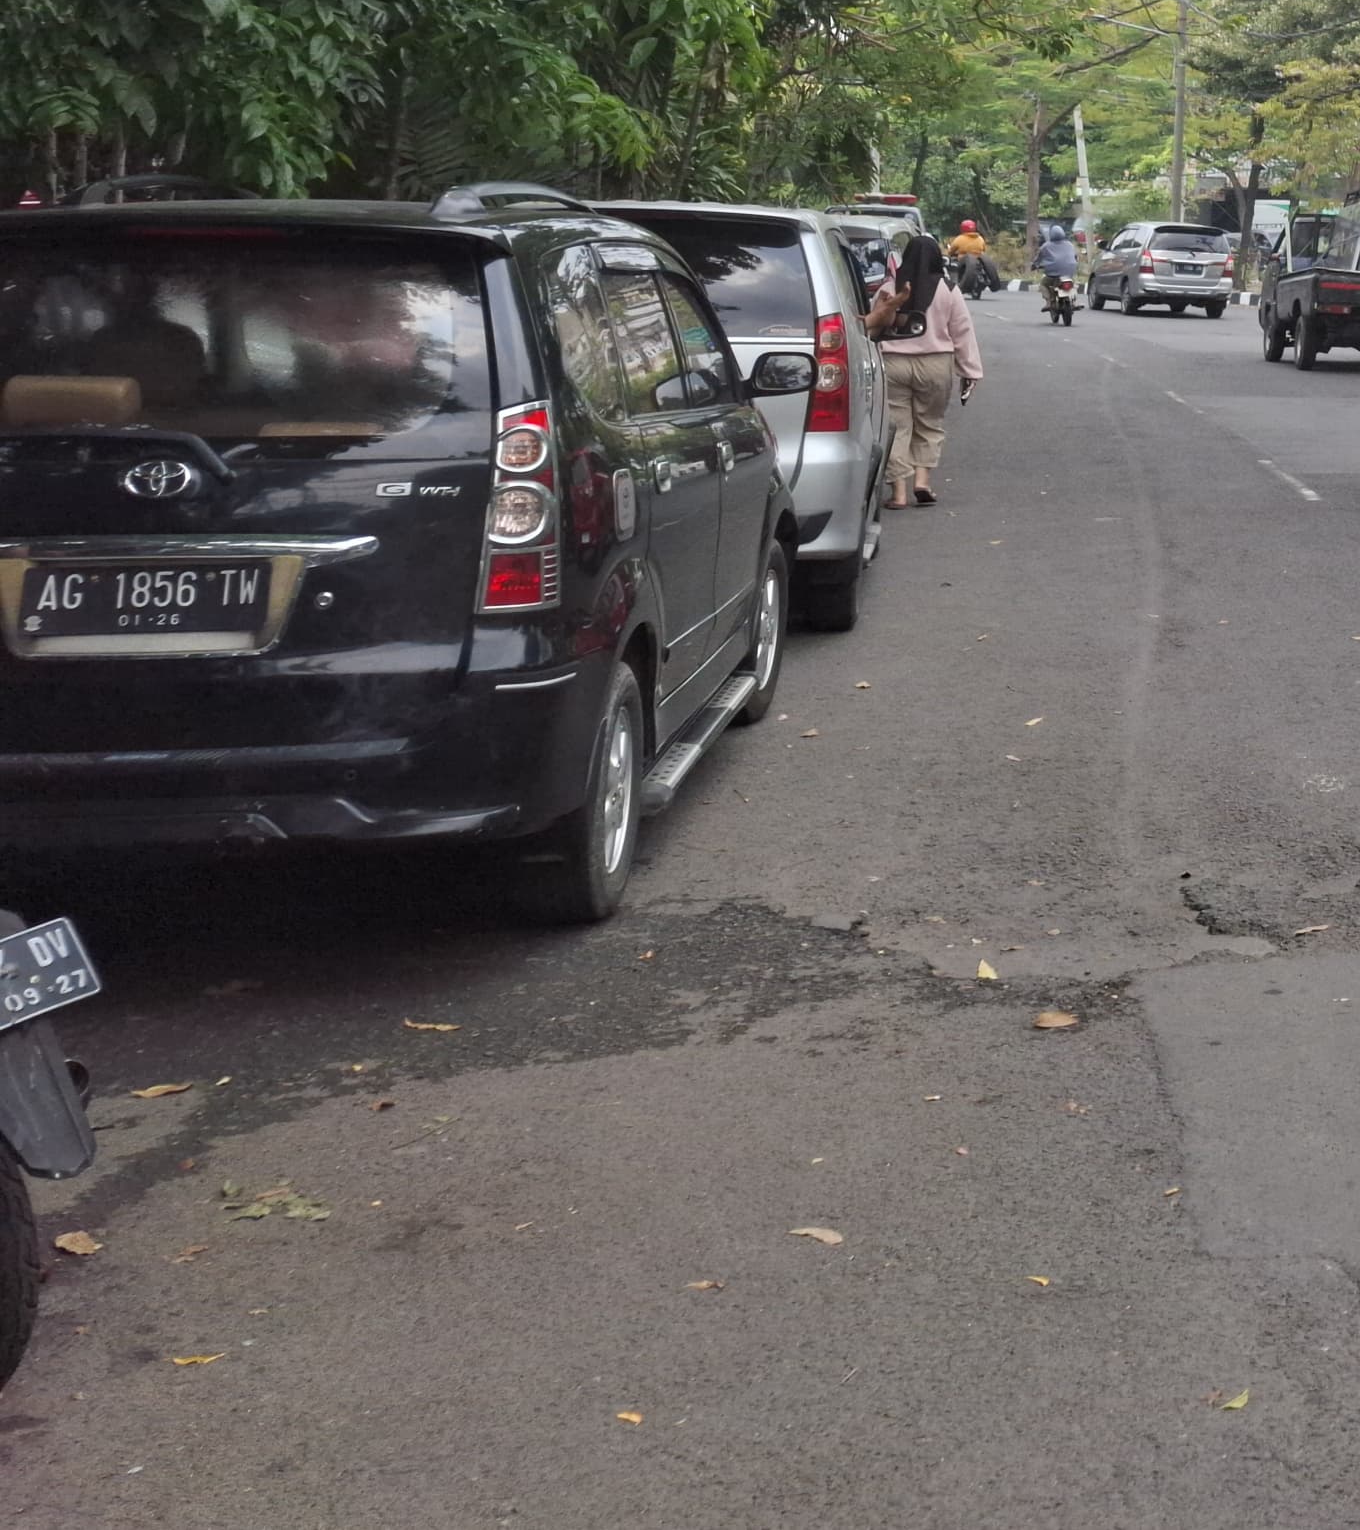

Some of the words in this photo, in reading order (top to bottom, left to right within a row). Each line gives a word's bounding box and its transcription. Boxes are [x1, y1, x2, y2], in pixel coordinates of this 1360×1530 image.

[36, 574, 85, 611] AG
[115, 571, 198, 610] 1856
[220, 568, 259, 607] TW
